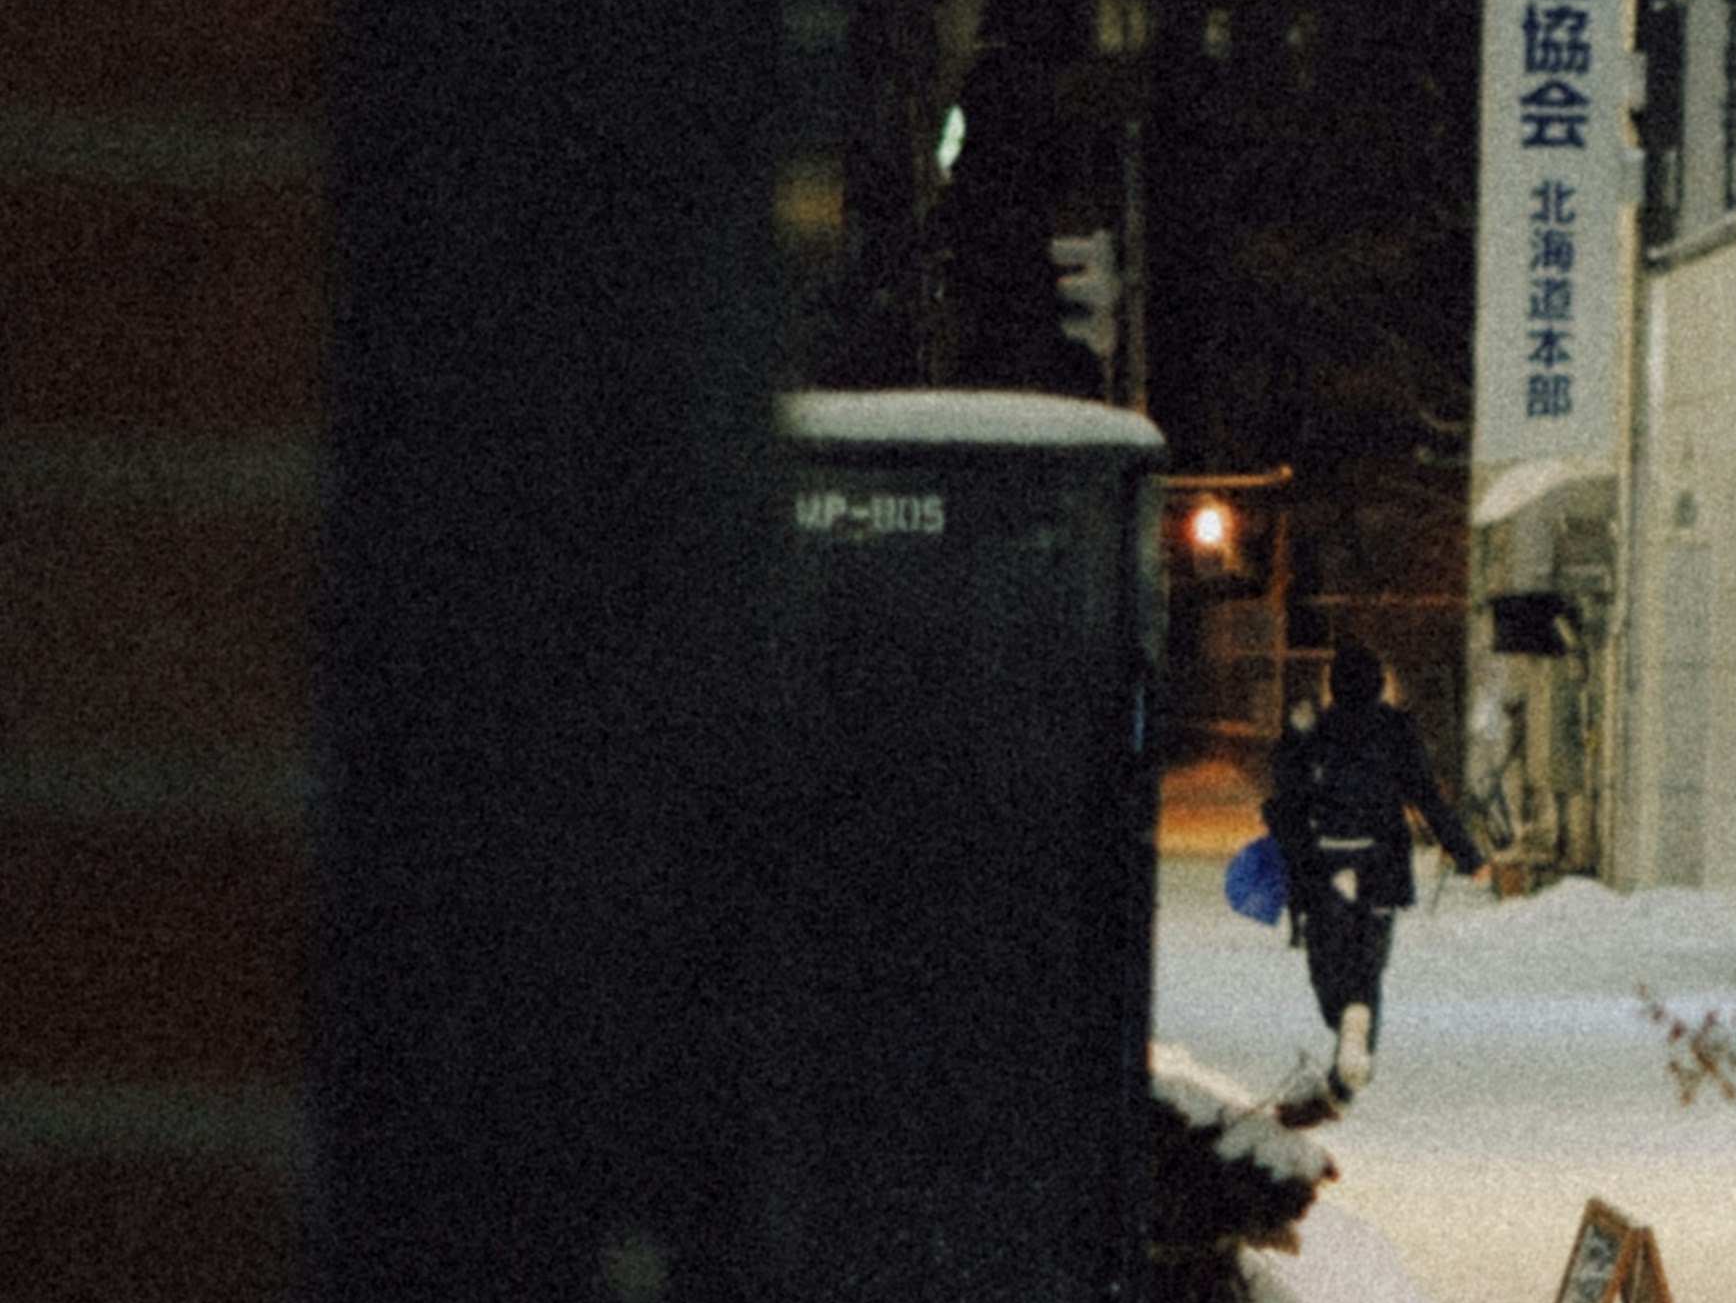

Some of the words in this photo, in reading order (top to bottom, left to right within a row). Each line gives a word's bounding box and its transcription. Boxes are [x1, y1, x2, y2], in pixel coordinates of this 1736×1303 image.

[1525, 179, 1579, 420] 北海道本部
